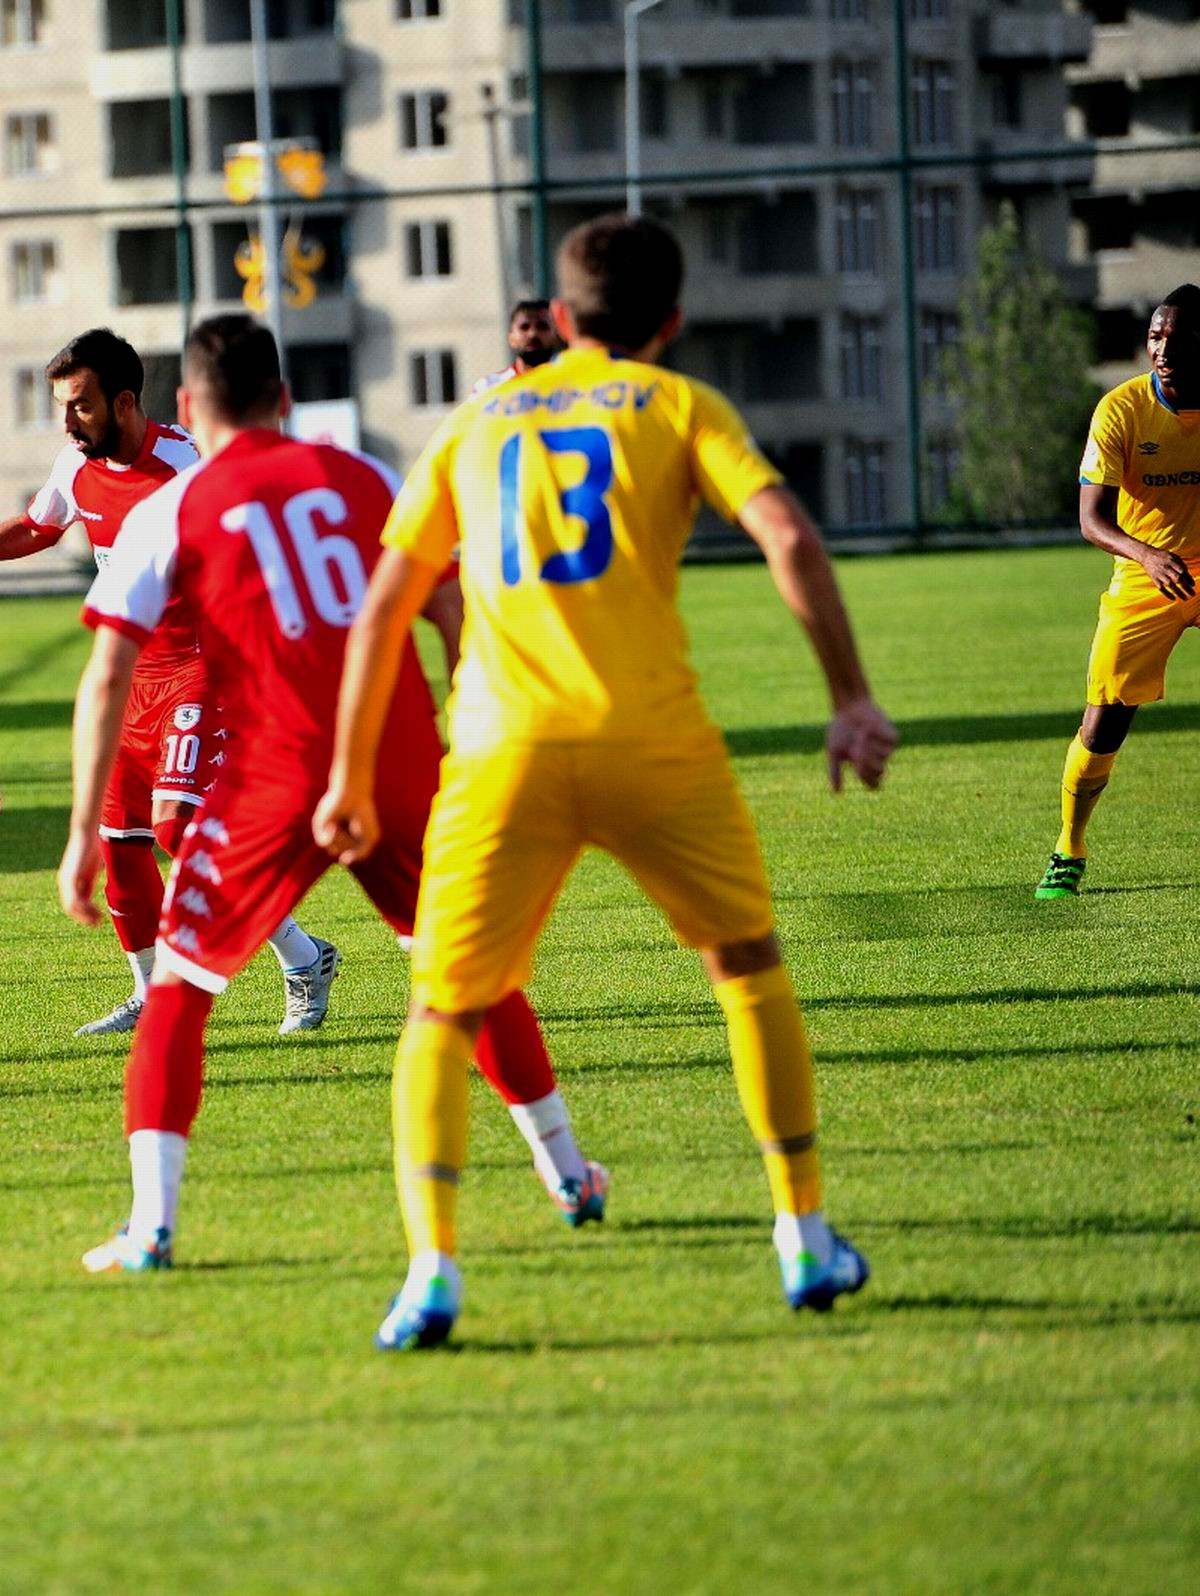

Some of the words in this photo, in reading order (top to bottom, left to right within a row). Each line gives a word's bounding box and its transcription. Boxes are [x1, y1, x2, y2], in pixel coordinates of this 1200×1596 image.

[220, 487, 368, 640] 16
[499, 425, 615, 587] 13
[164, 734, 200, 774] 10
